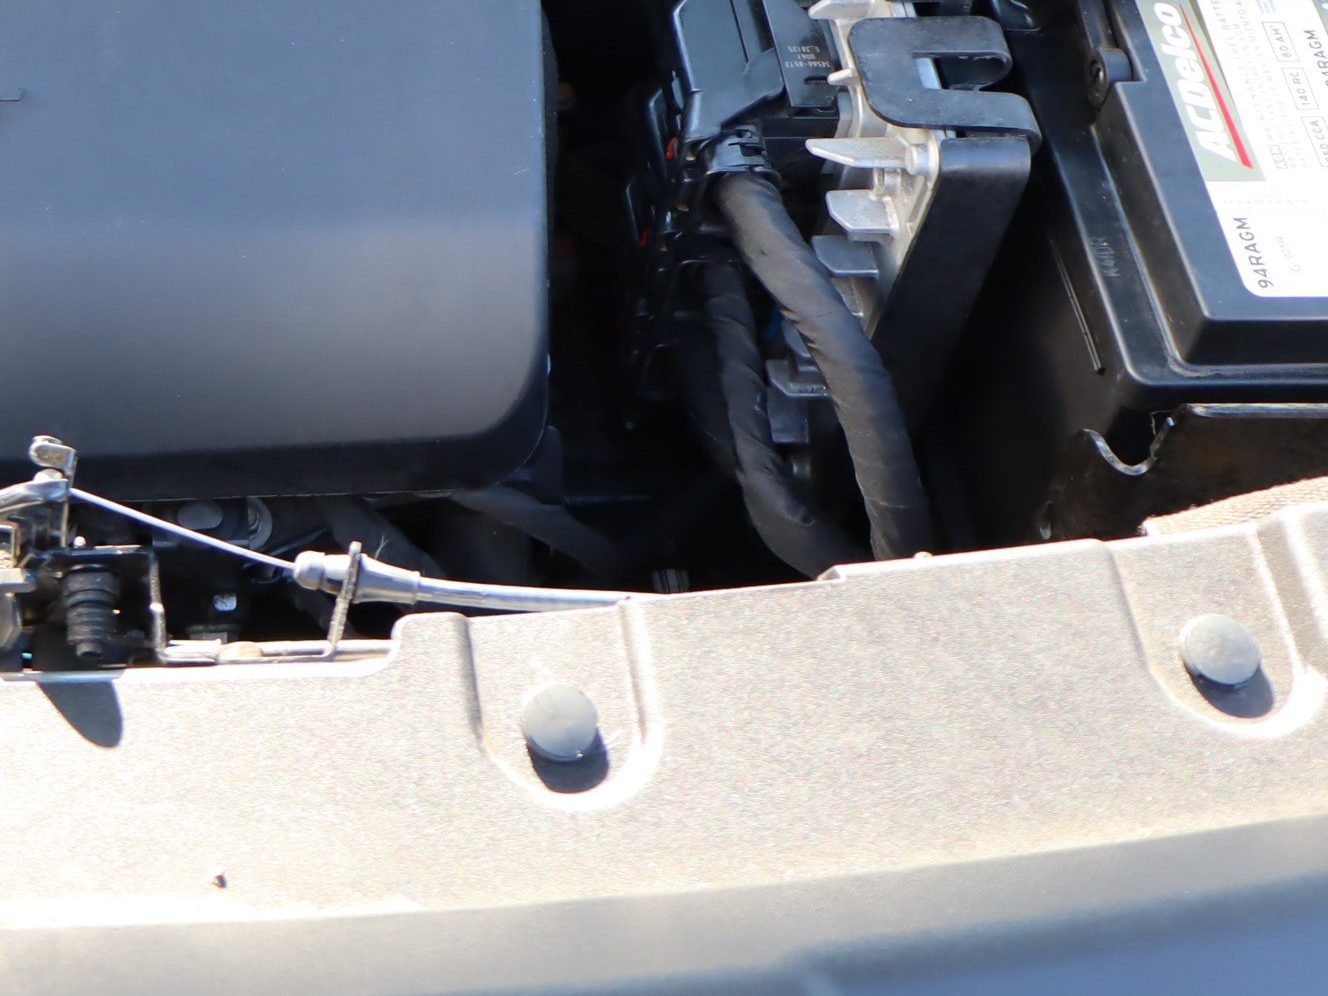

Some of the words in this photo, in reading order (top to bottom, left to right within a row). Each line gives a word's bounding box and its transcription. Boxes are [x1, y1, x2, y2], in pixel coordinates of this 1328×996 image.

[1278, 45, 1292, 58] 80
[1151, 2, 1238, 162] ACDelco
[1290, 72, 1304, 85] RC
[1296, 89, 1311, 106] 140
[1234, 216, 1274, 289] 94RAGM
